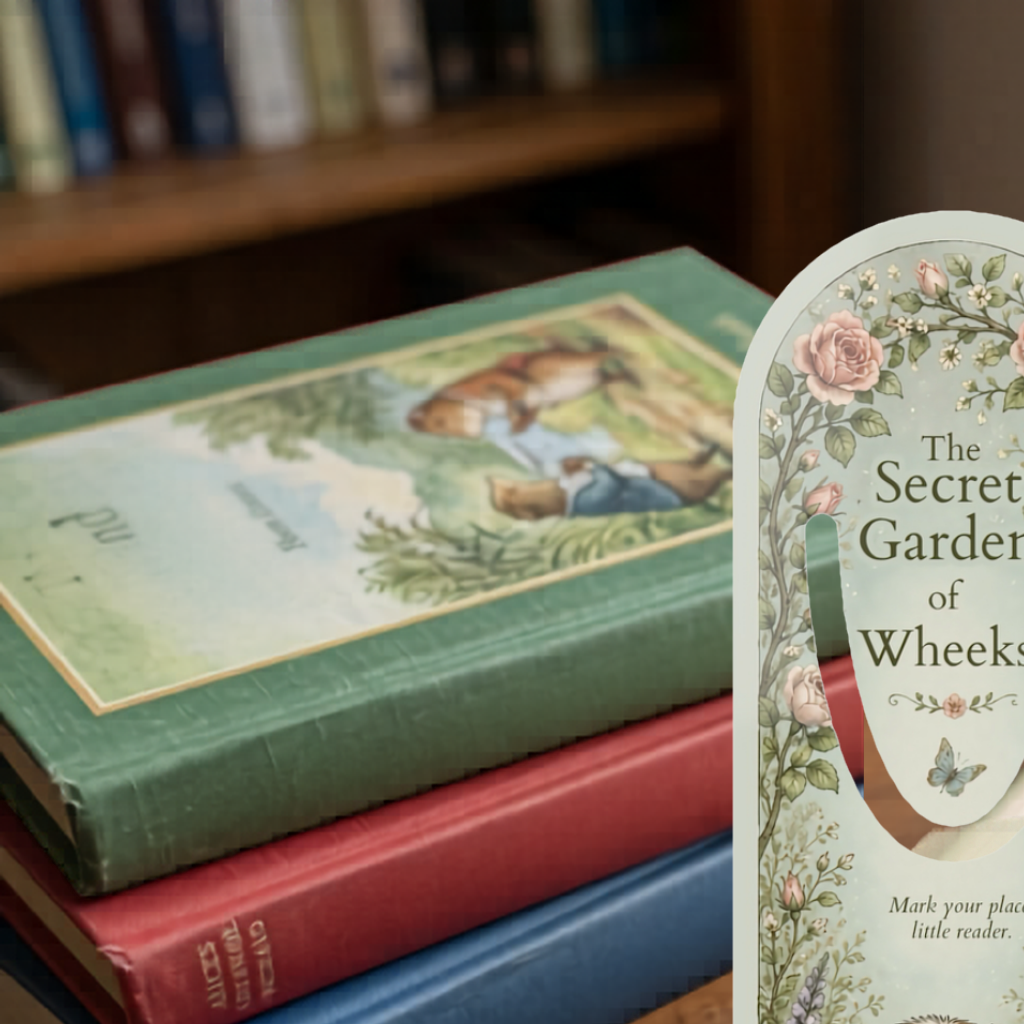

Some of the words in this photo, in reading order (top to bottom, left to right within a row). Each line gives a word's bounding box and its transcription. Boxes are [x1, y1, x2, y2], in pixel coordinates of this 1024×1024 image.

[921, 432, 981, 461] The
[876, 460, 1022, 503] Secret
[928, 579, 964, 610] of
[889, 895, 937, 914] Mark
[943, 901, 983, 920] your
[912, 920, 951, 939] little
[956, 920, 1012, 939] reader.
